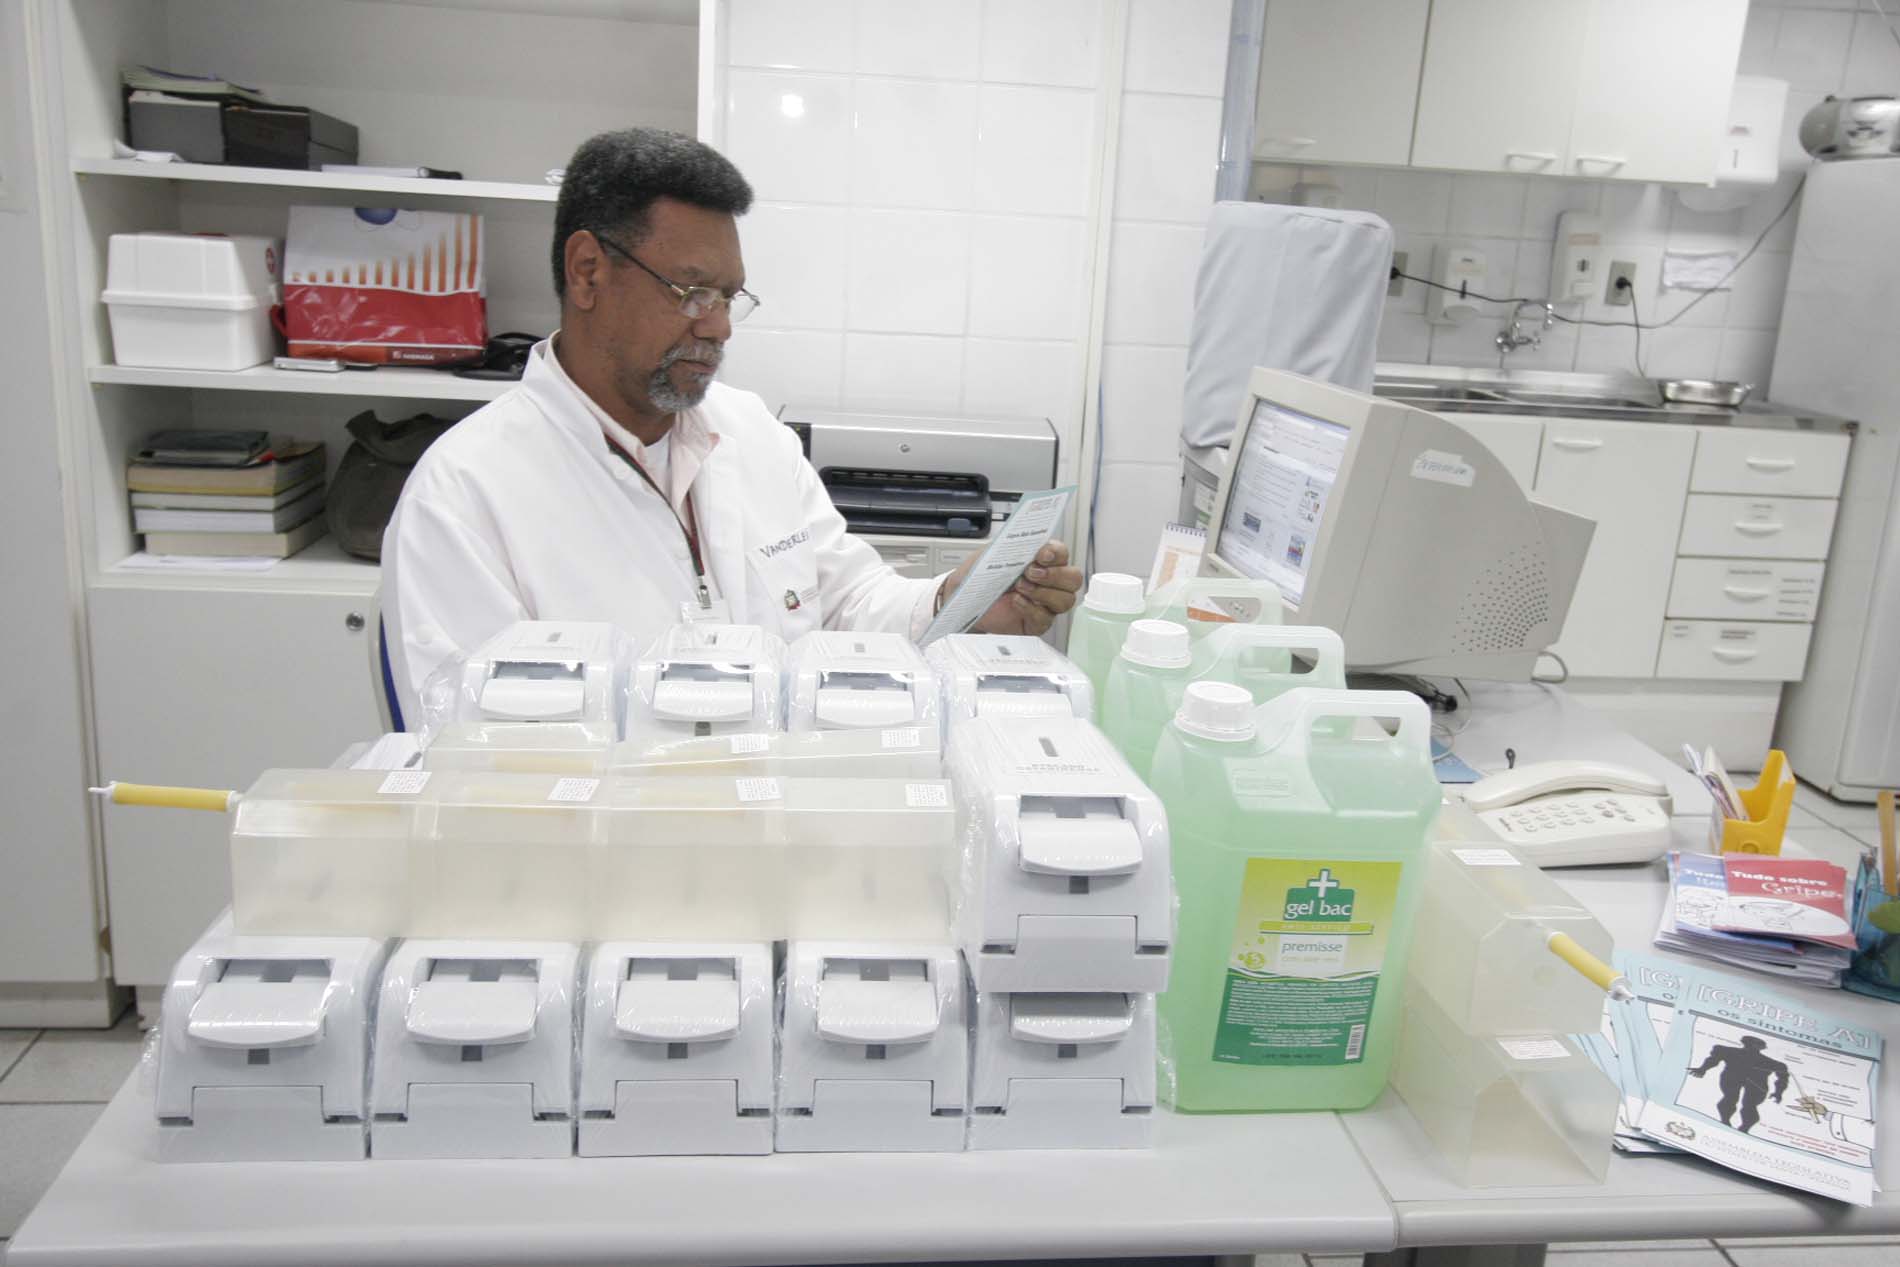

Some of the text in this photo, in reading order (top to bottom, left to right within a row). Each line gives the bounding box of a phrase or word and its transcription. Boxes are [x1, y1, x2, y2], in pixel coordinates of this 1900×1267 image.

[1731, 870, 1828, 886] Tudo sobre
[1284, 900, 1352, 919] gel bac
[1281, 942, 1343, 954] premisse
[1746, 1017, 1843, 1049] sintomas
